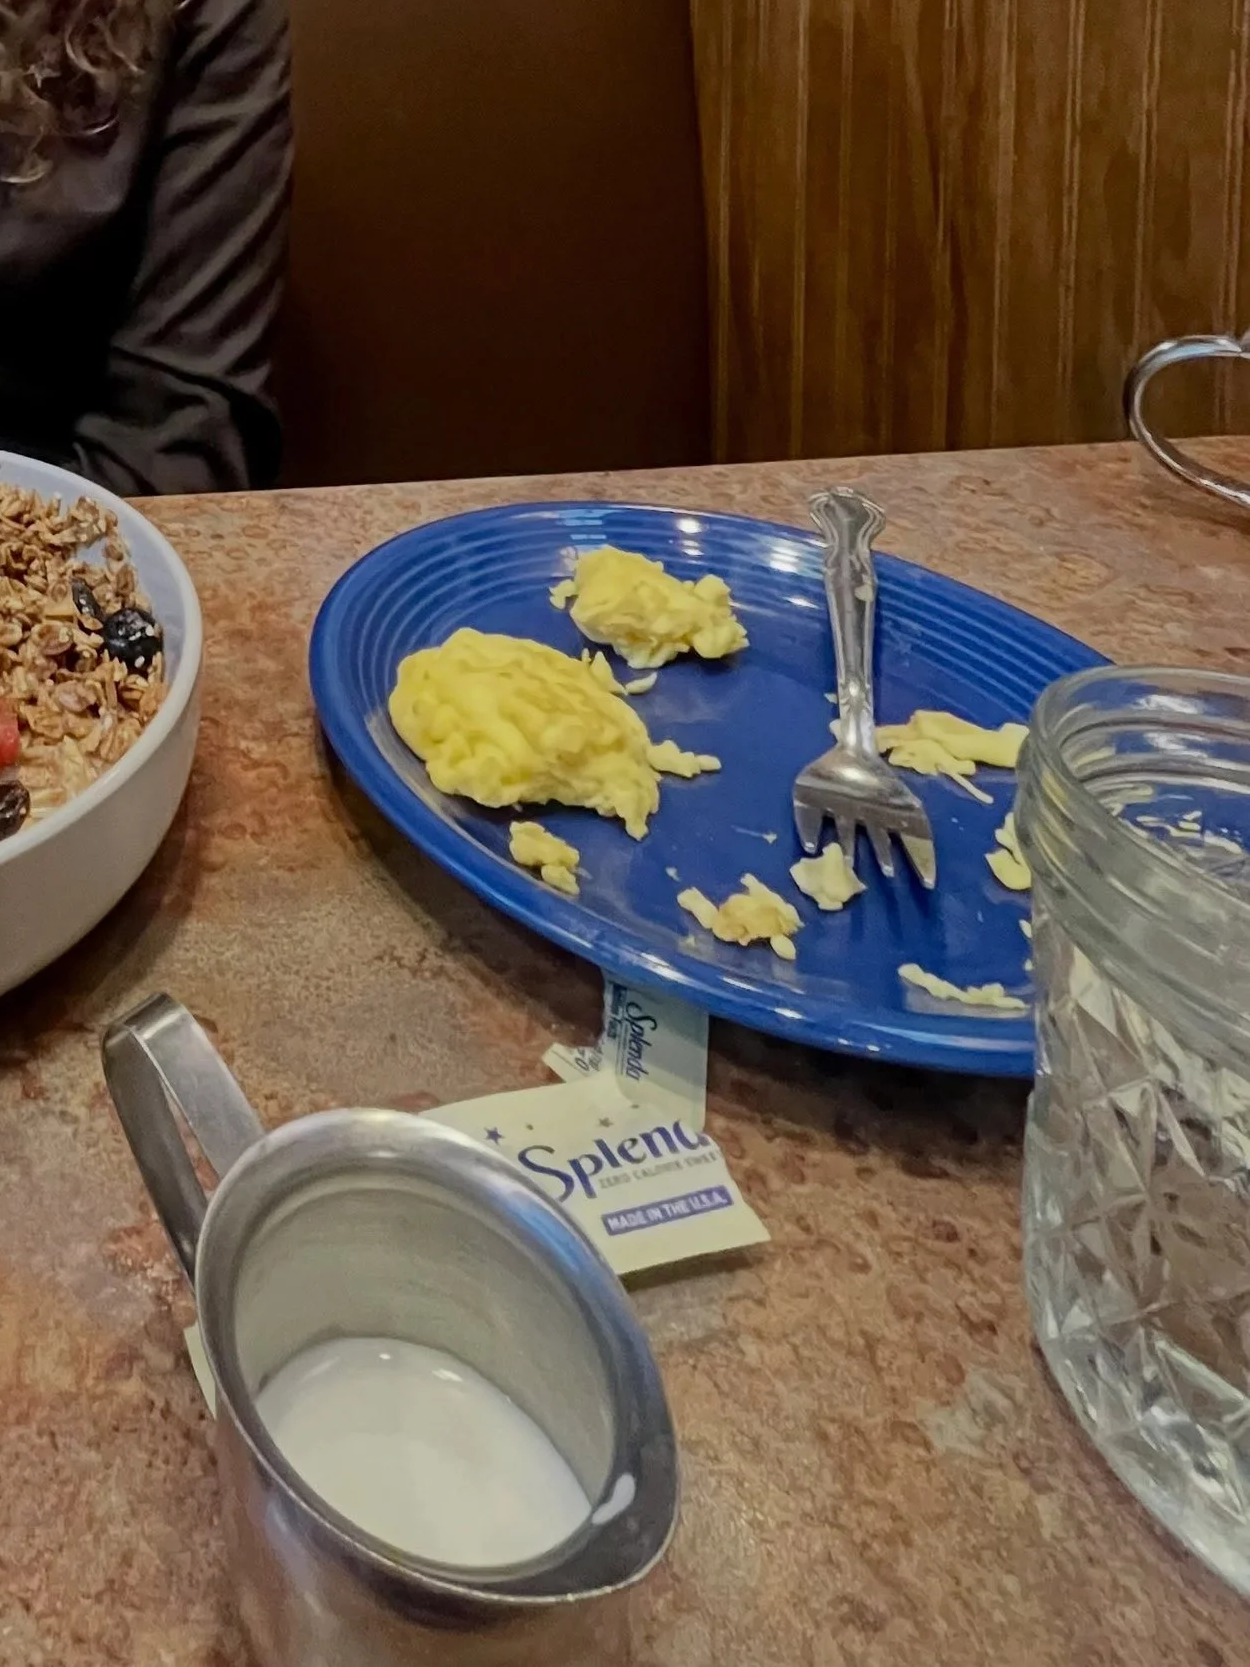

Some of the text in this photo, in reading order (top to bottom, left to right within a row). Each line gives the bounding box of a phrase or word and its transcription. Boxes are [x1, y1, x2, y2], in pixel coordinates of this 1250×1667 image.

[626, 1001, 658, 1082] Splenda
[518, 1119, 711, 1203] Splend
[607, 1191, 728, 1231] MADE IN THE U.S.A.
